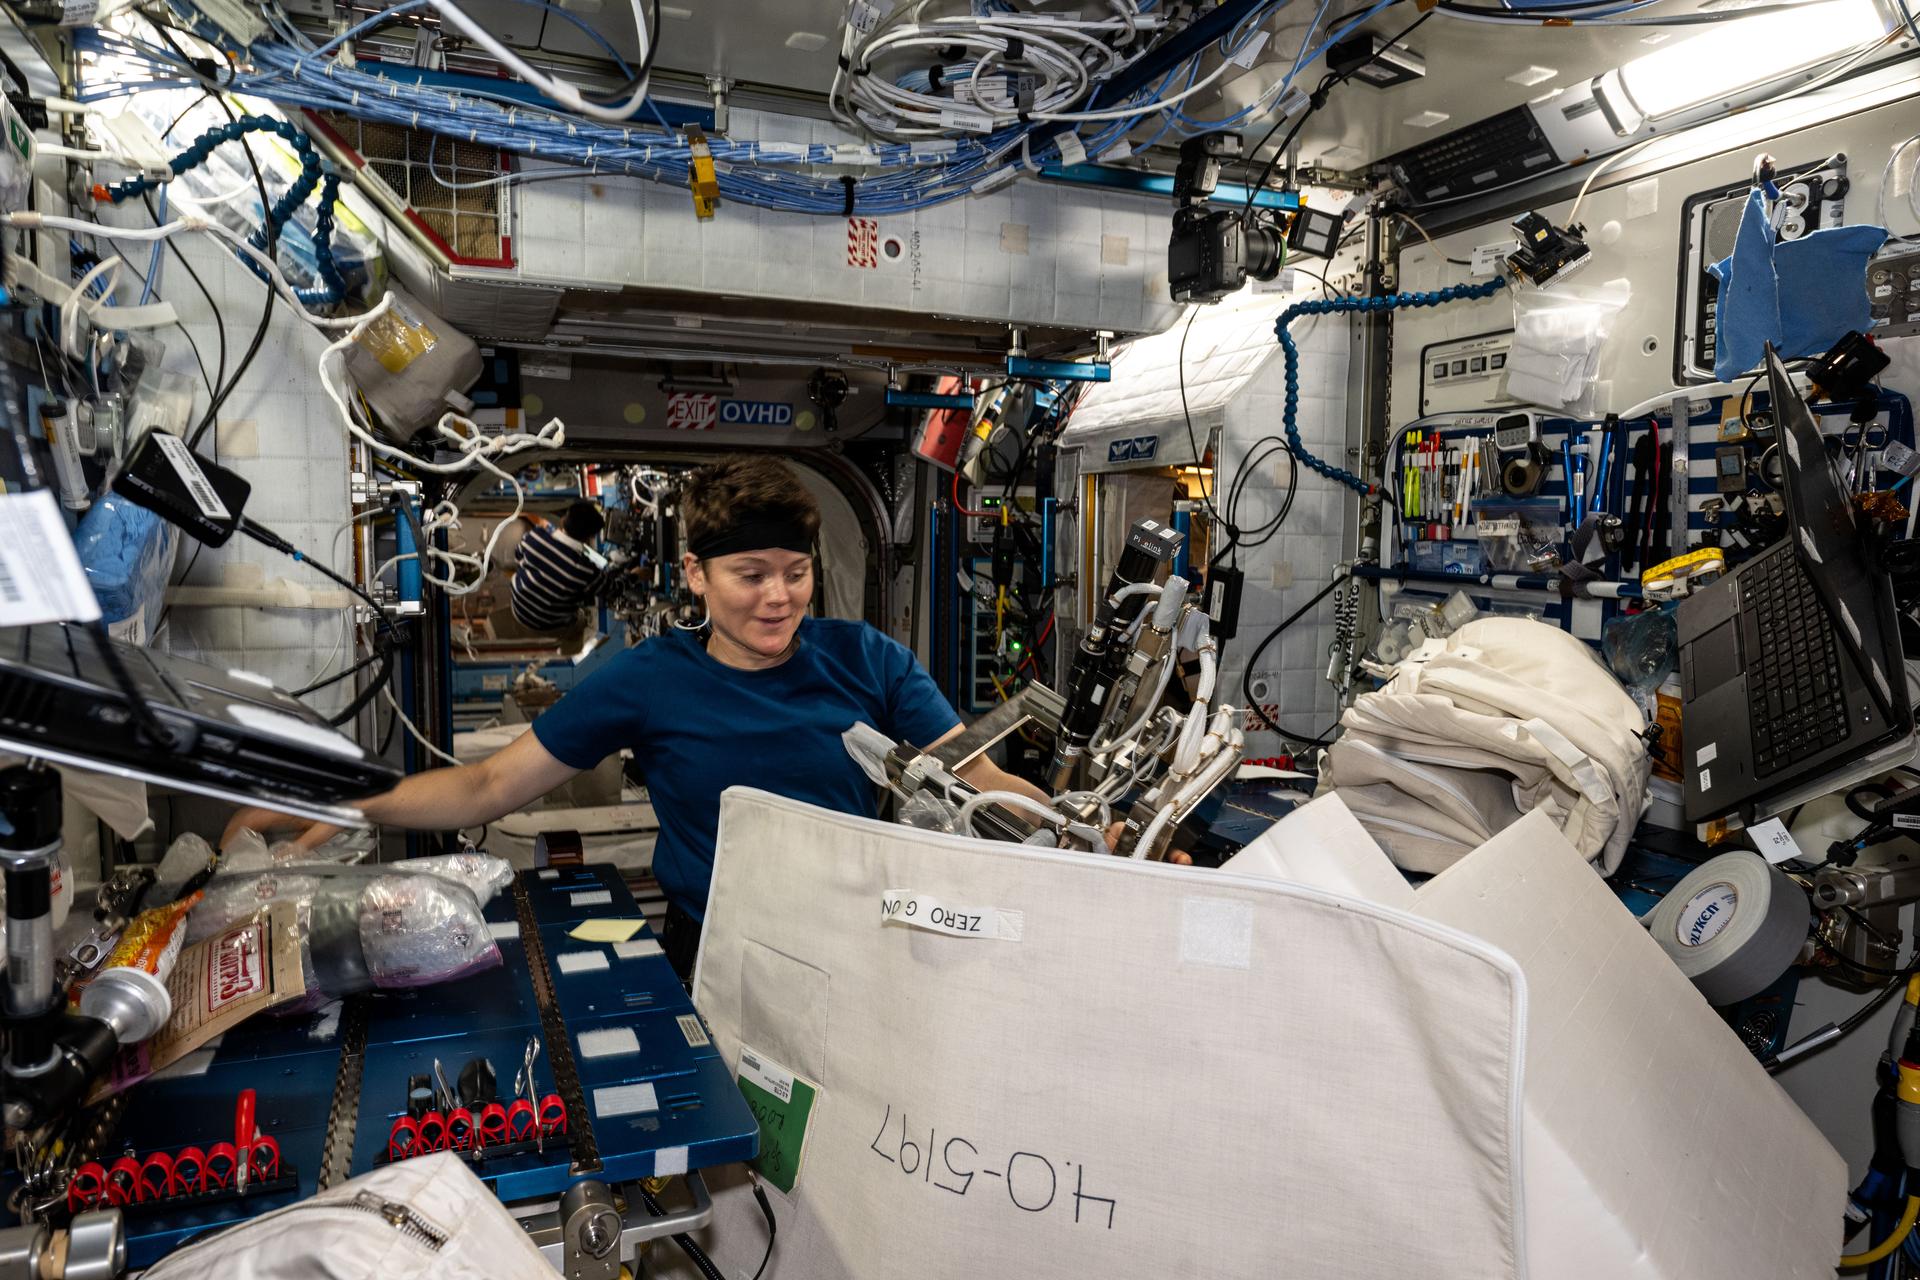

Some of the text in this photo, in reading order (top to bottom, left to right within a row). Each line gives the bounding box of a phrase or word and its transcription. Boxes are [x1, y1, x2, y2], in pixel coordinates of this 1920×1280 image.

[675, 400, 709, 420] EXIT
[722, 402, 791, 423] OVHD
[905, 900, 917, 917] G
[930, 907, 982, 932] ZERO
[1689, 902, 1720, 945] OLYKEN
[871, 1104, 1116, 1230] 4.0-5197
